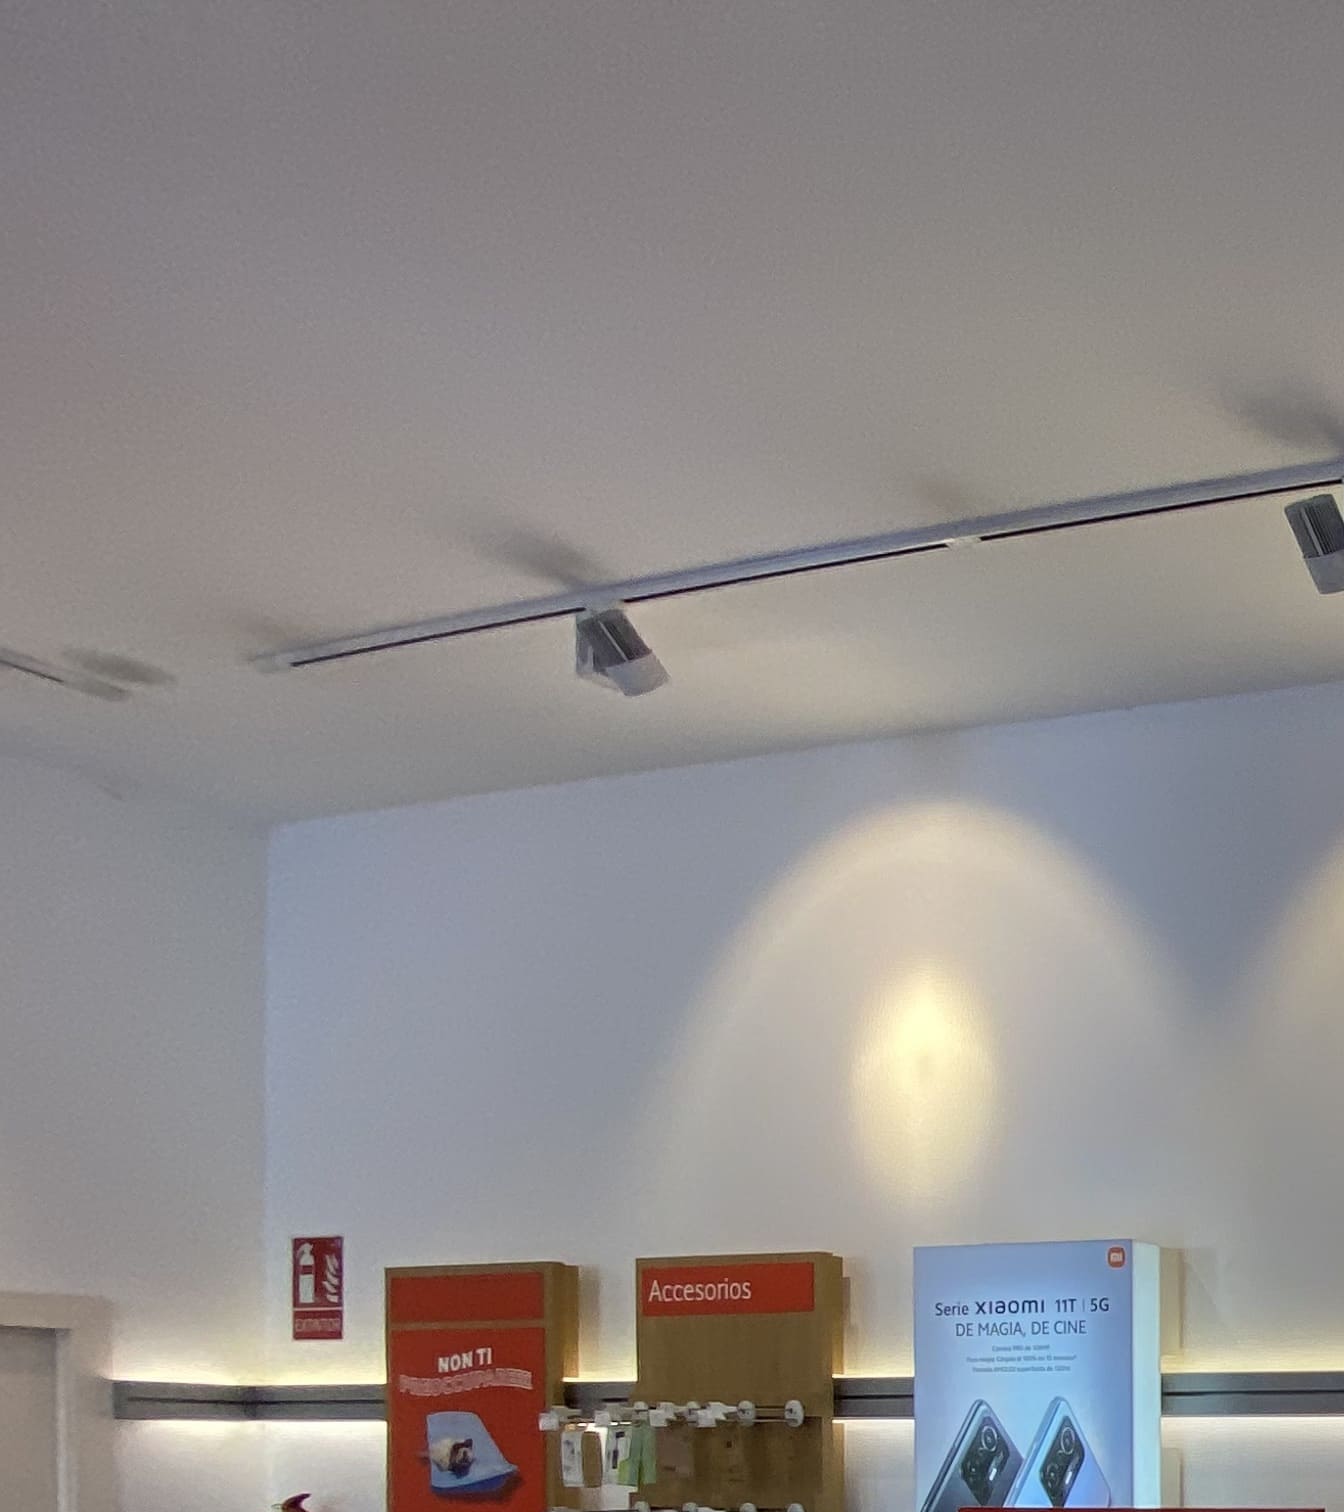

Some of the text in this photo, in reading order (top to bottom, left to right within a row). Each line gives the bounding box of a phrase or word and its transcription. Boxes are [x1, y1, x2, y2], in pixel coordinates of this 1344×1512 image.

[648, 1278, 752, 1302] Accesorios
[935, 1302, 969, 1316] Serie
[1055, 1298, 1077, 1313] 11T
[1090, 1297, 1110, 1313] 5G
[955, 1319, 1088, 1338] DE MAGIA, DE CINE
[438, 1347, 493, 1373] NON TI
